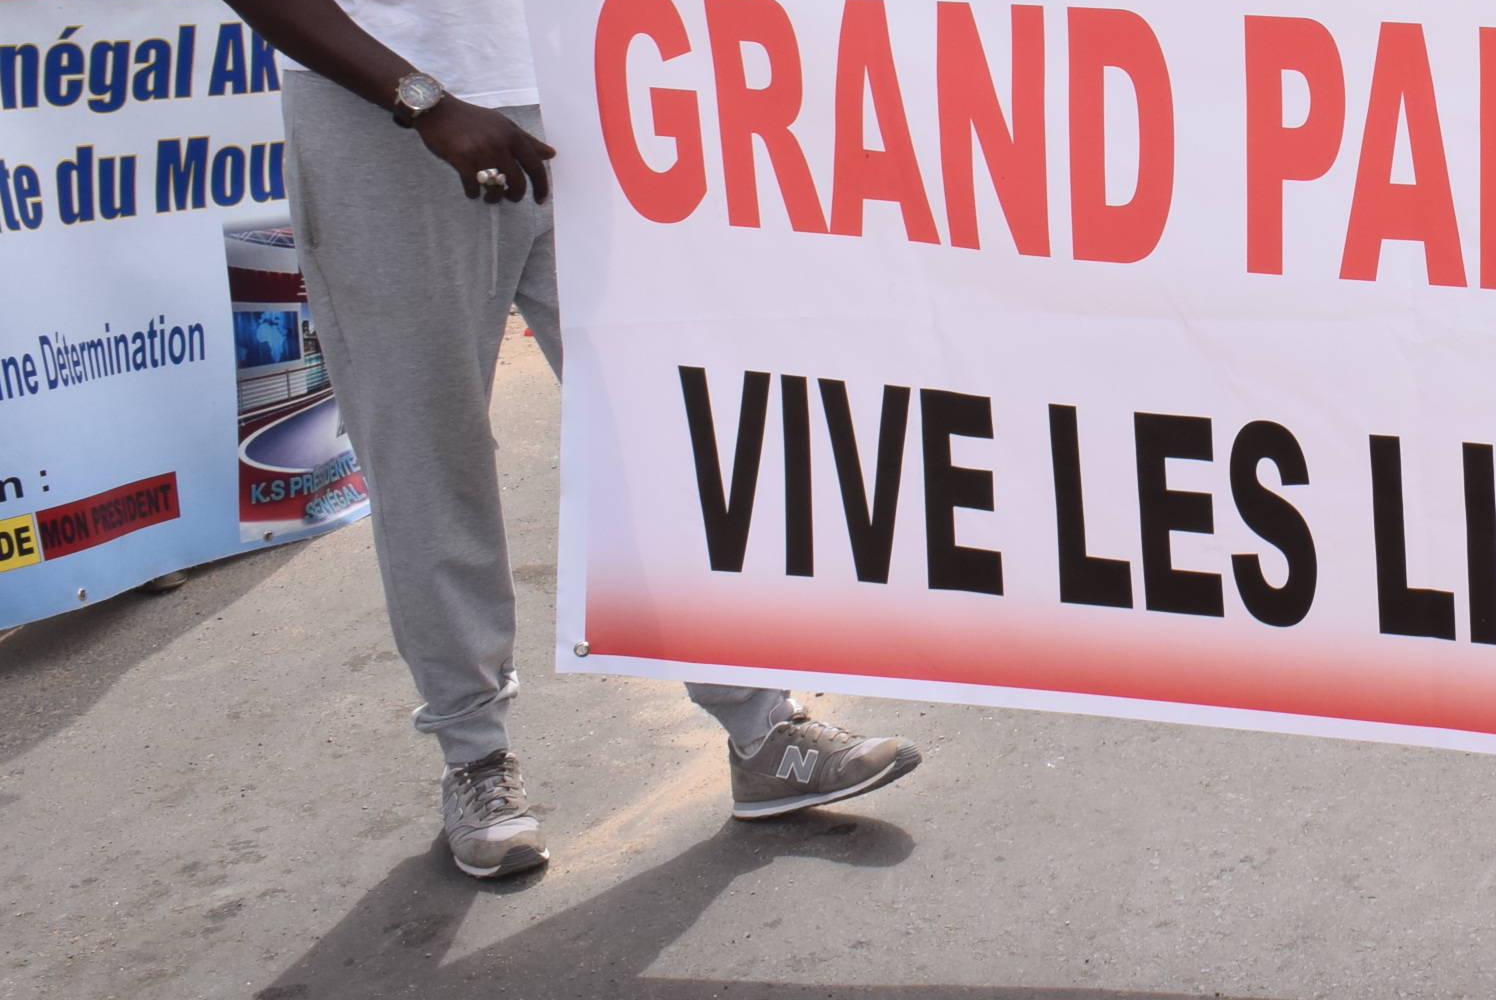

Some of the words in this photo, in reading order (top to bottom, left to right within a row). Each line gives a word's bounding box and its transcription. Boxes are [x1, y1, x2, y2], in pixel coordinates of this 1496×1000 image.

[55, 144, 137, 226] du
[39, 314, 206, 390] Détermination
[40, 510, 91, 550] MON
[304, 483, 367, 522] SÉNÉGAL
[678, 365, 1004, 597] VIVE
[1048, 403, 1318, 628] LES
